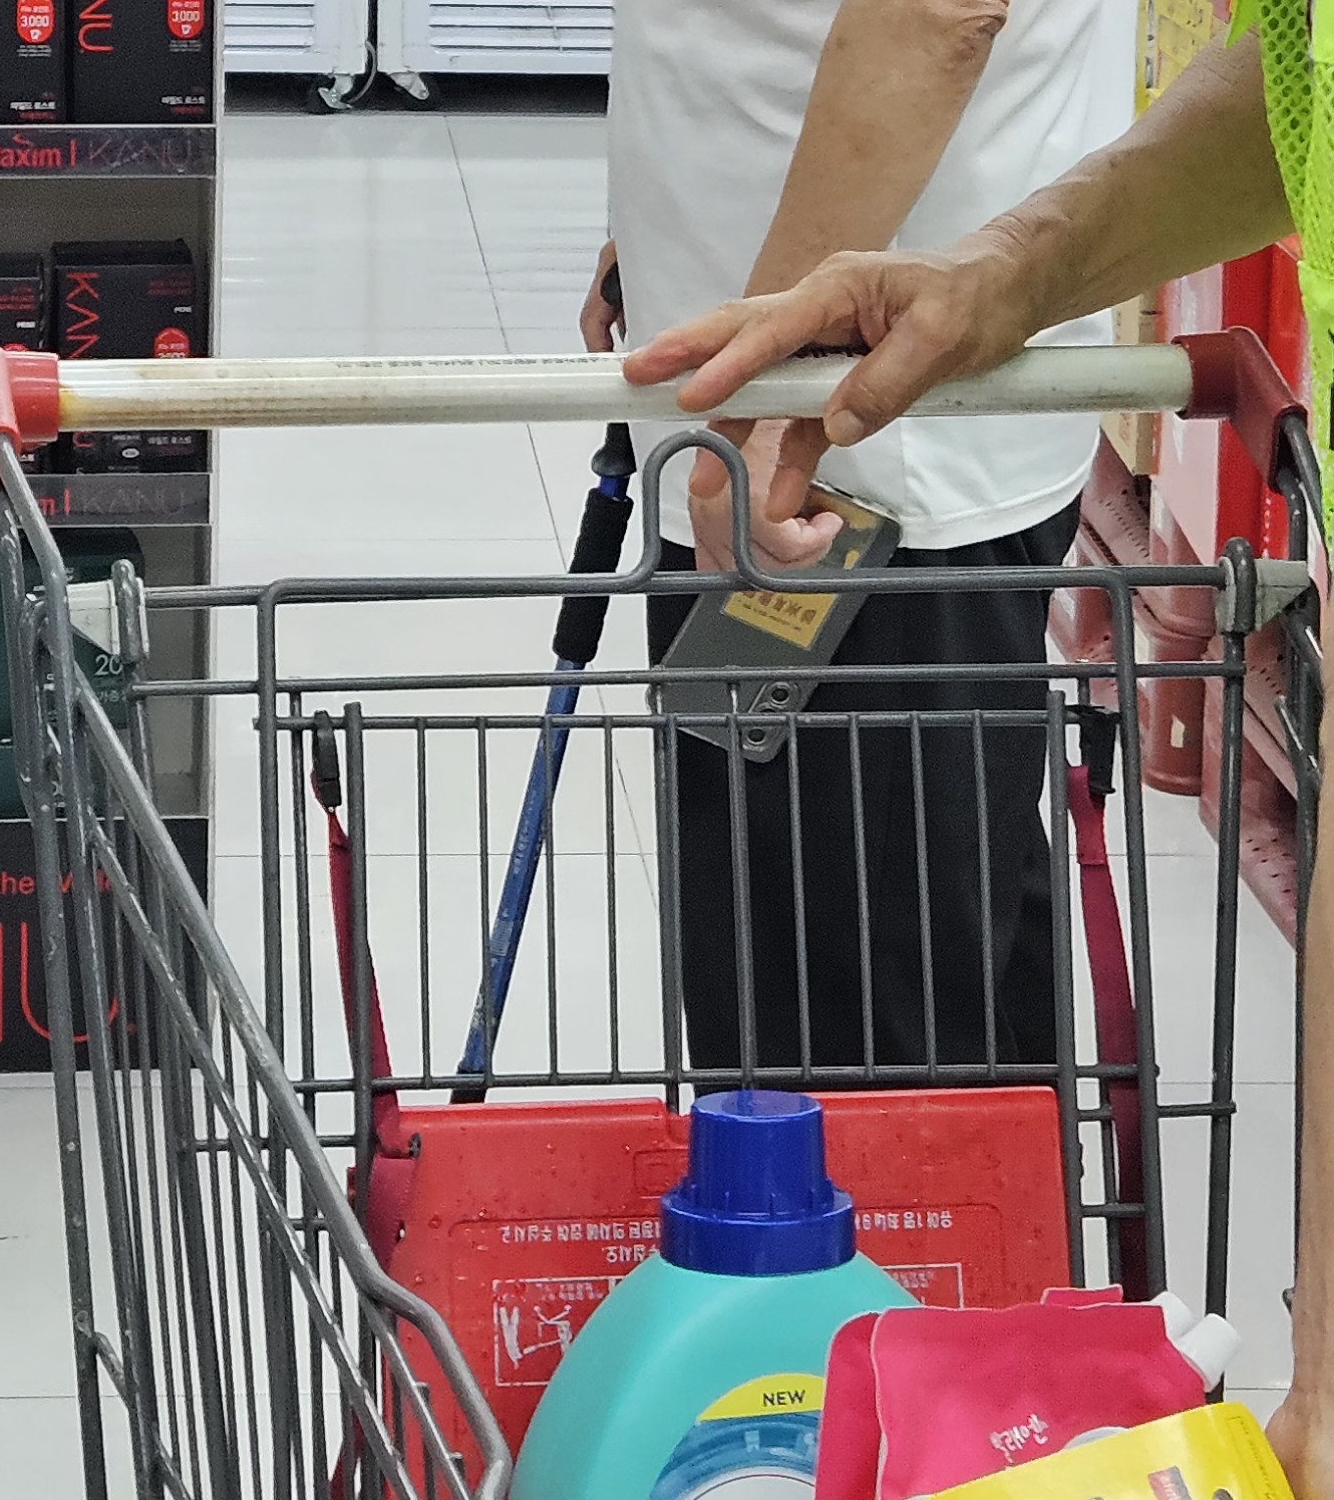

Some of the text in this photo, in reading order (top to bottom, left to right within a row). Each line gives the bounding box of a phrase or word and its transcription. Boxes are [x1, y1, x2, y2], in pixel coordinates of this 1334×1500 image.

[66, 271, 100, 359] KAN
[95, 654, 124, 677] 20
[762, 1389, 807, 1409] NEW
